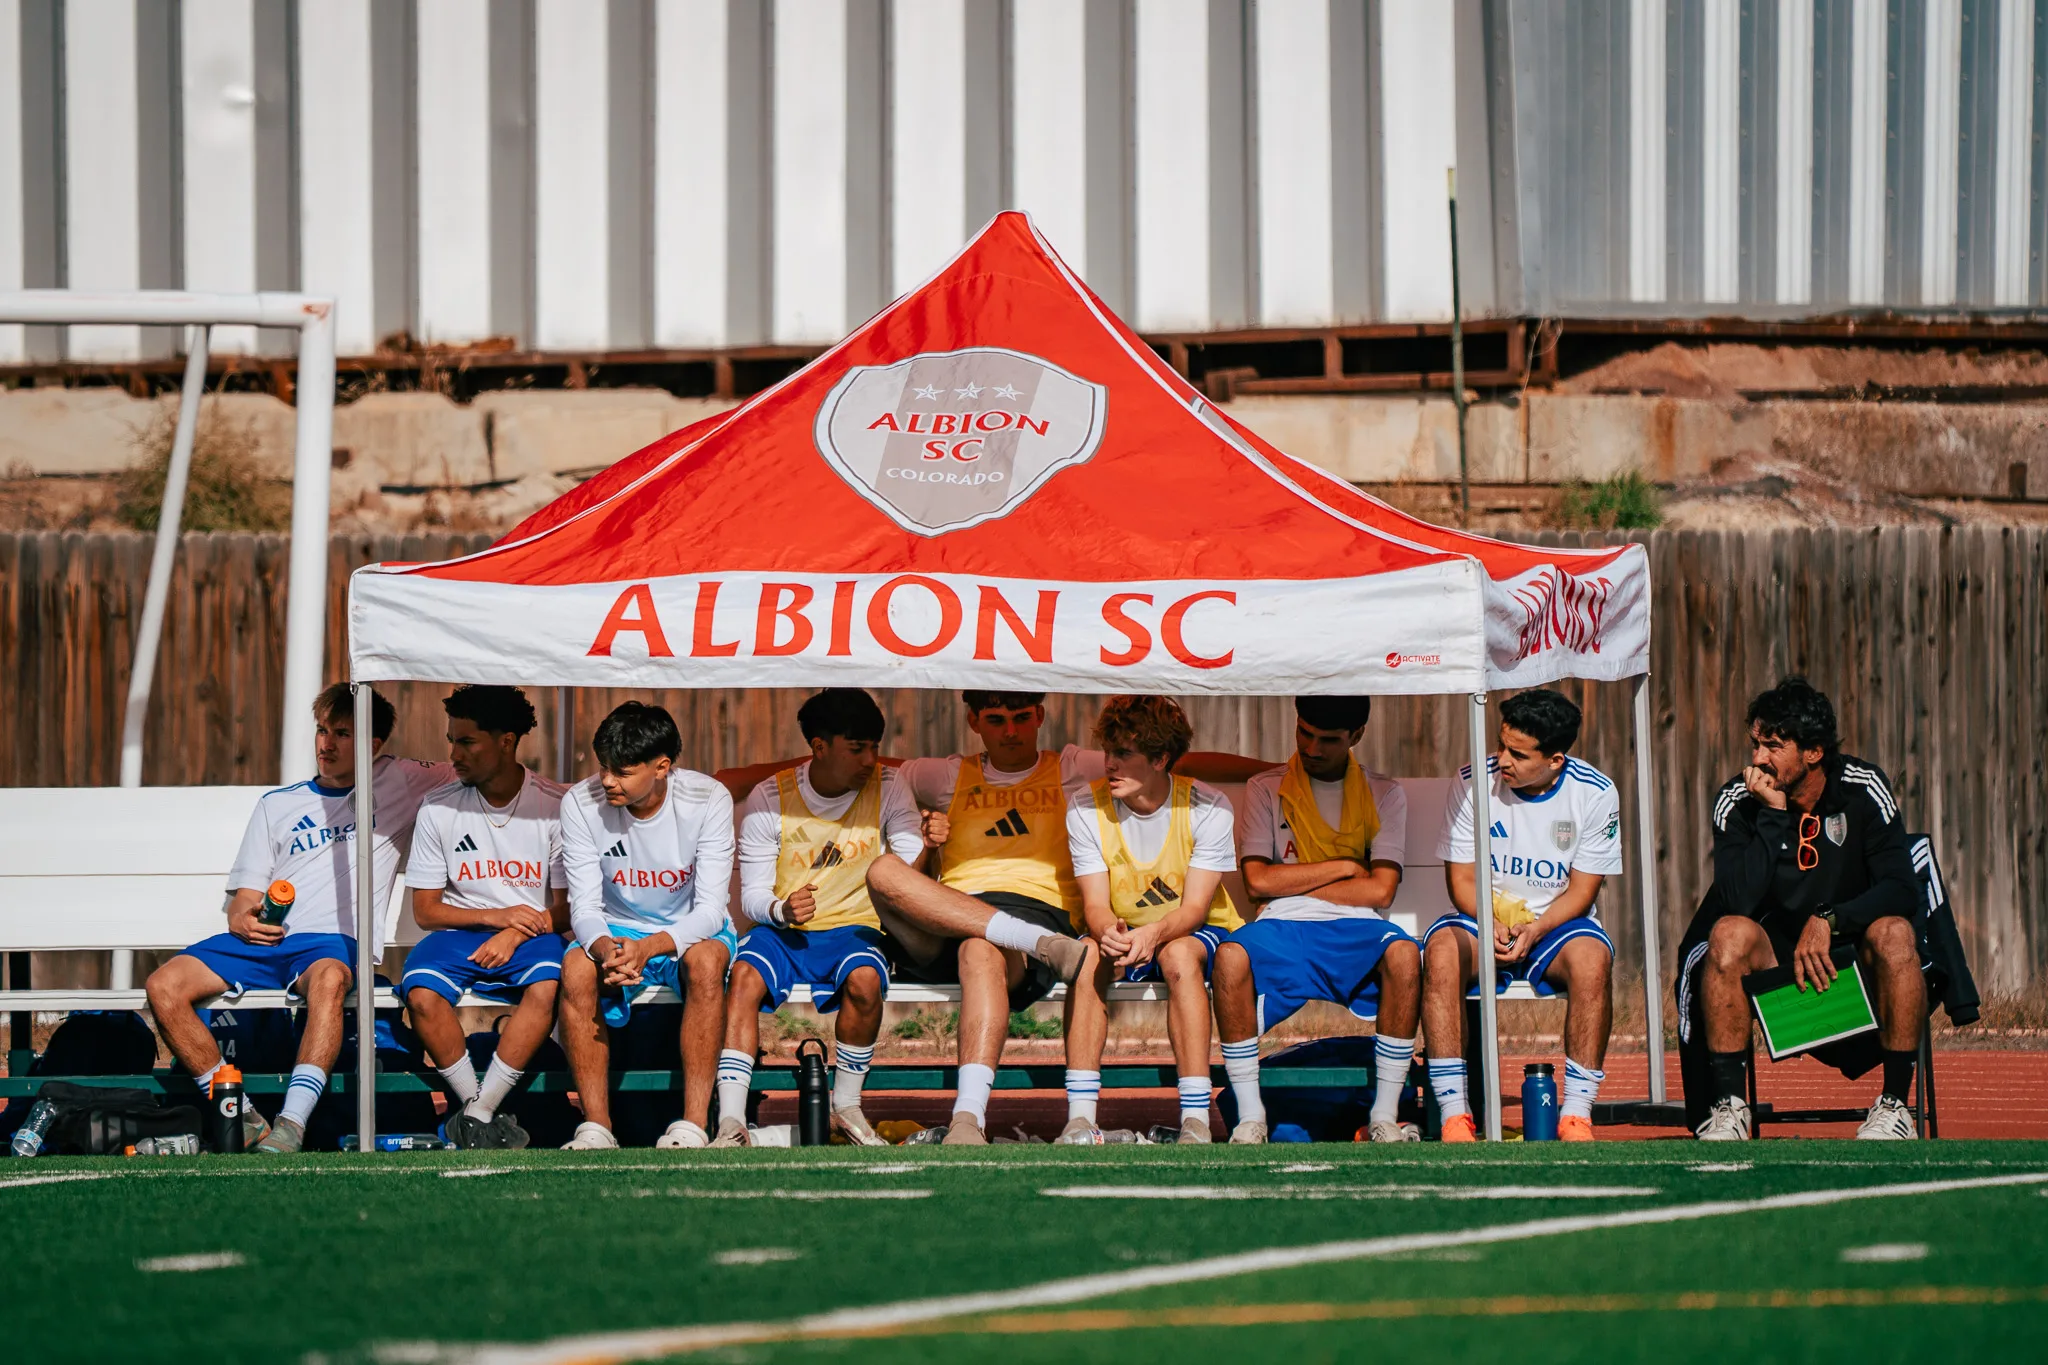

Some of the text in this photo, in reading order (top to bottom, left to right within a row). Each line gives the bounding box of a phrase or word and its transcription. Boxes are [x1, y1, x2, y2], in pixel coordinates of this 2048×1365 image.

[866, 411, 1050, 437] ALBION
[923, 439, 983, 462] SC
[886, 467, 1005, 485] COLORADO
[586, 574, 1237, 669] ALBION SC
[963, 786, 1060, 811] ALBION
[1019, 806, 1058, 814] OLORADO
[334, 833, 355, 843] COLO
[457, 859, 542, 881] ALBION
[611, 863, 693, 888] ALBION
[502, 880, 542, 888] COLORADO
[1527, 879, 1568, 889] COLORAD
[220, 1096, 238, 1118] G
[387, 1137, 413, 1145] smart
